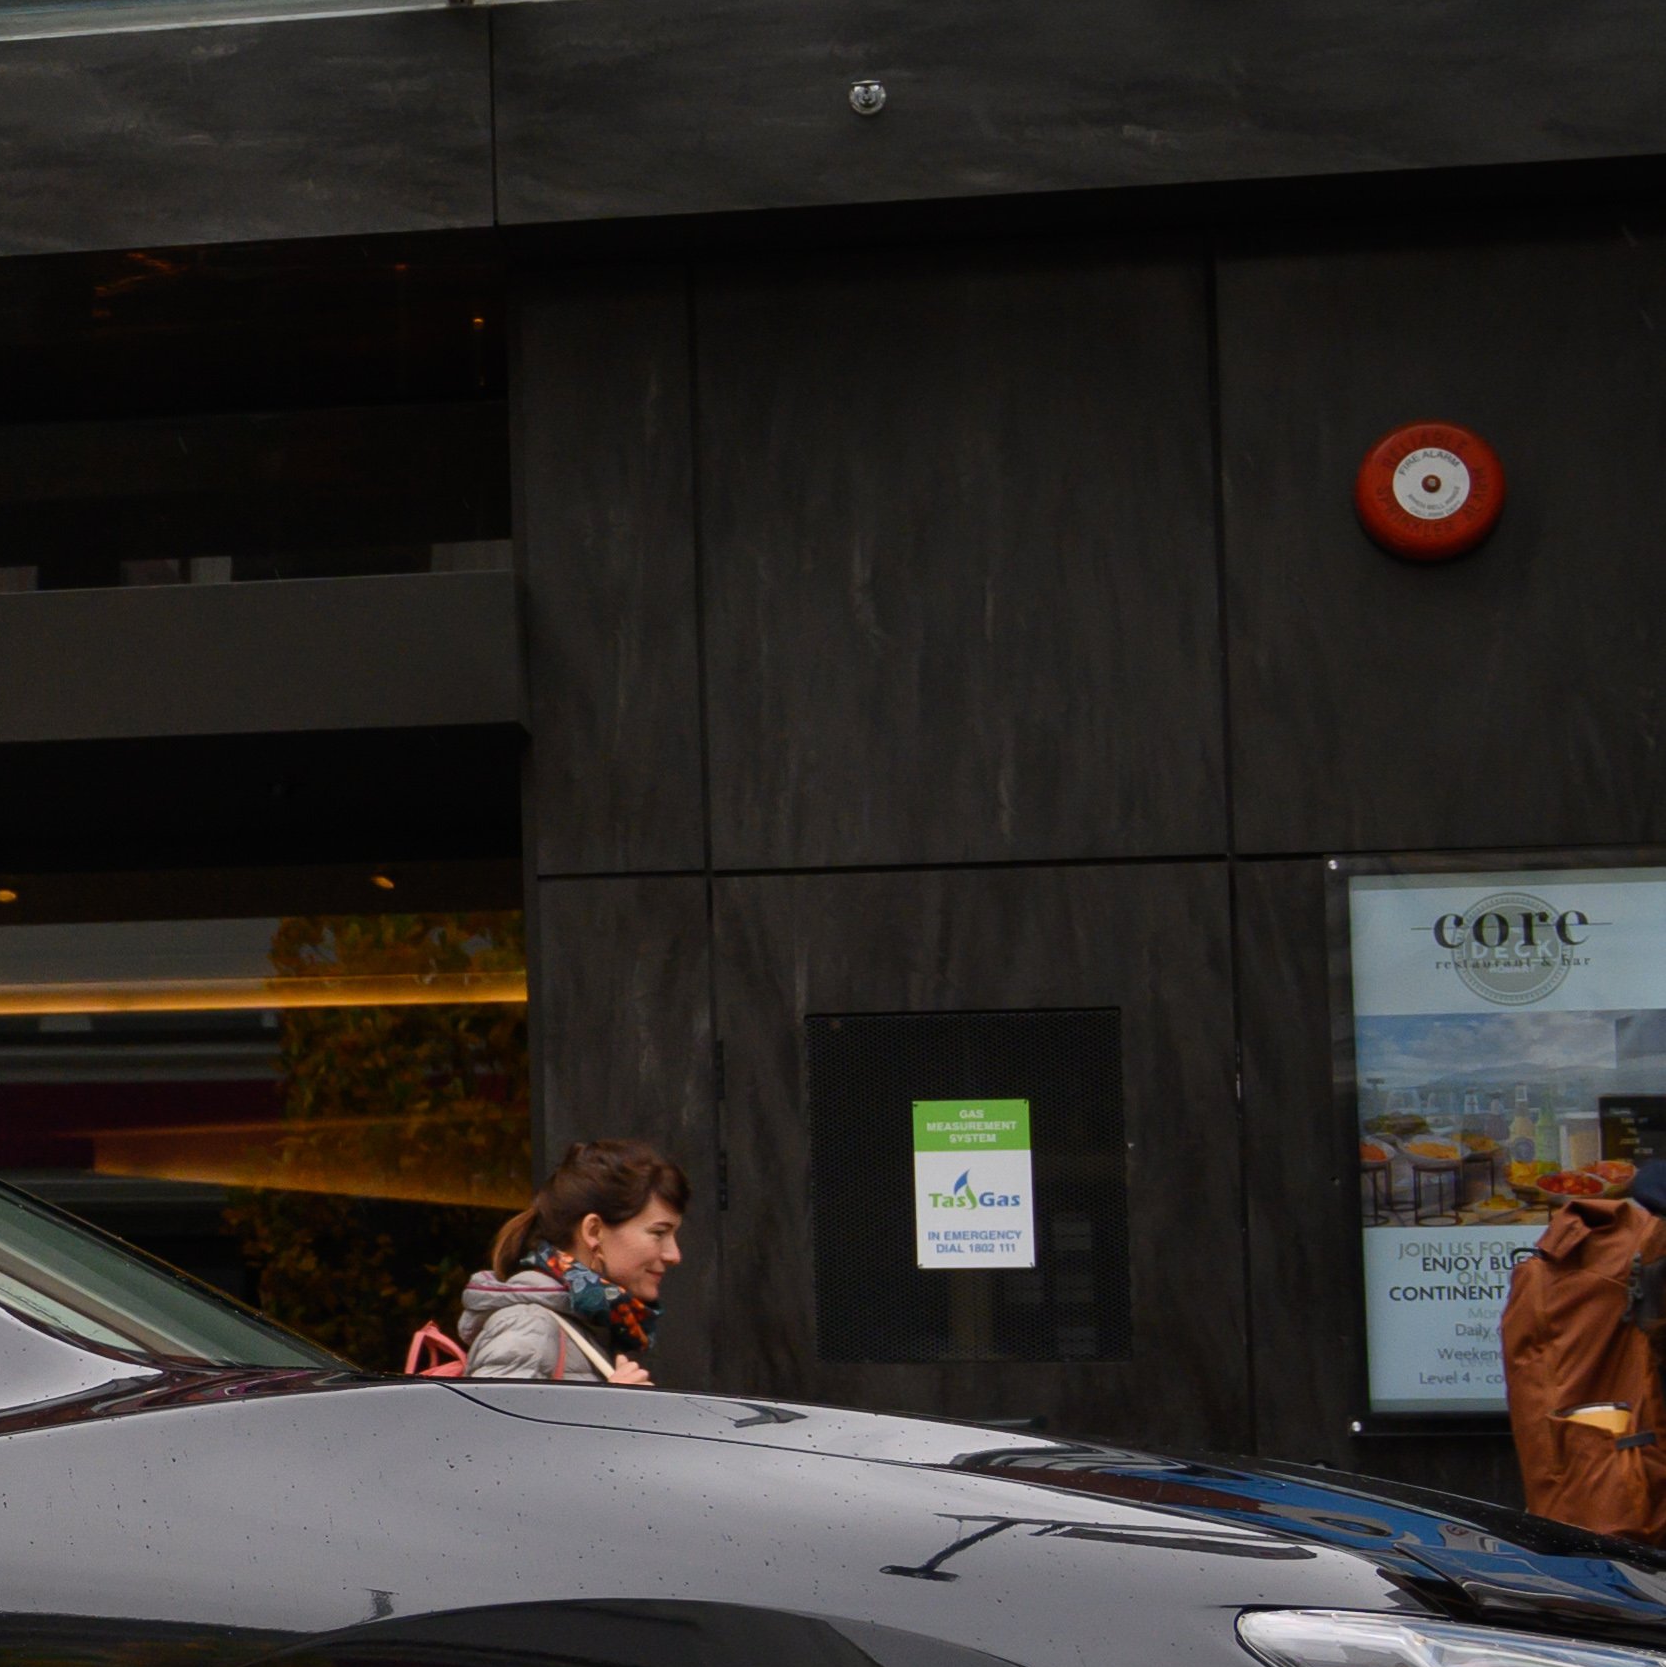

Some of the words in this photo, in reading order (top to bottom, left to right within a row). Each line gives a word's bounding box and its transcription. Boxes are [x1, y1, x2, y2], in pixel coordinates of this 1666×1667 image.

[1399, 453, 1420, 476] FIRE
[1422, 449, 1461, 468] ALARM
[1433, 909, 1591, 949] core
[1471, 939, 1554, 959] DECK
[1435, 957, 1532, 970] restaurant
[1561, 953, 1591, 967] bar
[959, 1109, 984, 1119] GAS
[926, 1120, 1017, 1132] MEASUREMENT
[949, 1133, 997, 1144] SYSTEM
[928, 1230, 940, 1241] IN
[944, 1230, 1023, 1241] EMERGENCY
[936, 1243, 964, 1254] DIAL
[969, 1243, 994, 1254] 1802
[1000, 1243, 1016, 1253] 111
[1398, 1241, 1442, 1260] JOIN
[1448, 1241, 1473, 1256] US
[1422, 1256, 1484, 1274] ENJOY
[1457, 1271, 1488, 1286] ON
[1389, 1285, 1506, 1301] CONTINENT
[1455, 1322, 1491, 1340] Daily
[1419, 1370, 1457, 1385] Level
[1462, 1371, 1470, 1383] 4
